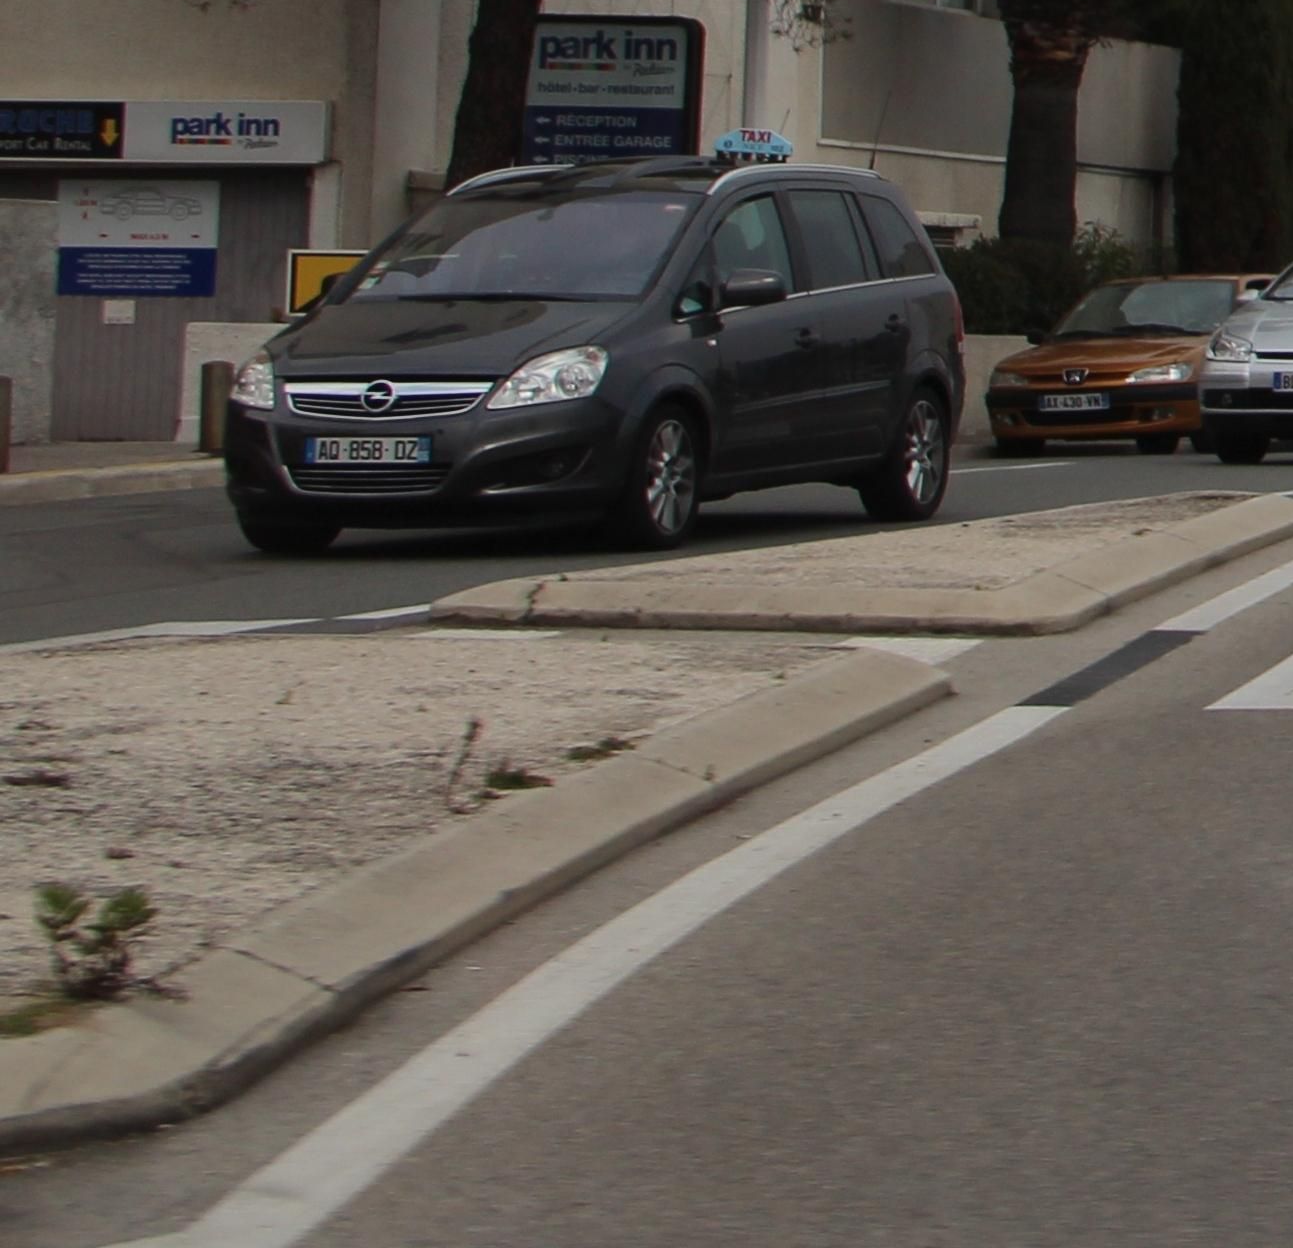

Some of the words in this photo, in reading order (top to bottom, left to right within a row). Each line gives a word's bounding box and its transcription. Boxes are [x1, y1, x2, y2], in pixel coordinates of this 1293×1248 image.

[538, 30, 618, 70] park
[624, 31, 678, 61] inn
[169, 113, 231, 144] park
[237, 113, 280, 136] inn
[555, 113, 638, 128] RÉCEPTION
[554, 133, 610, 148] ENTRÉE
[613, 136, 673, 149] GARAGE
[740, 130, 772, 143] TAXI
